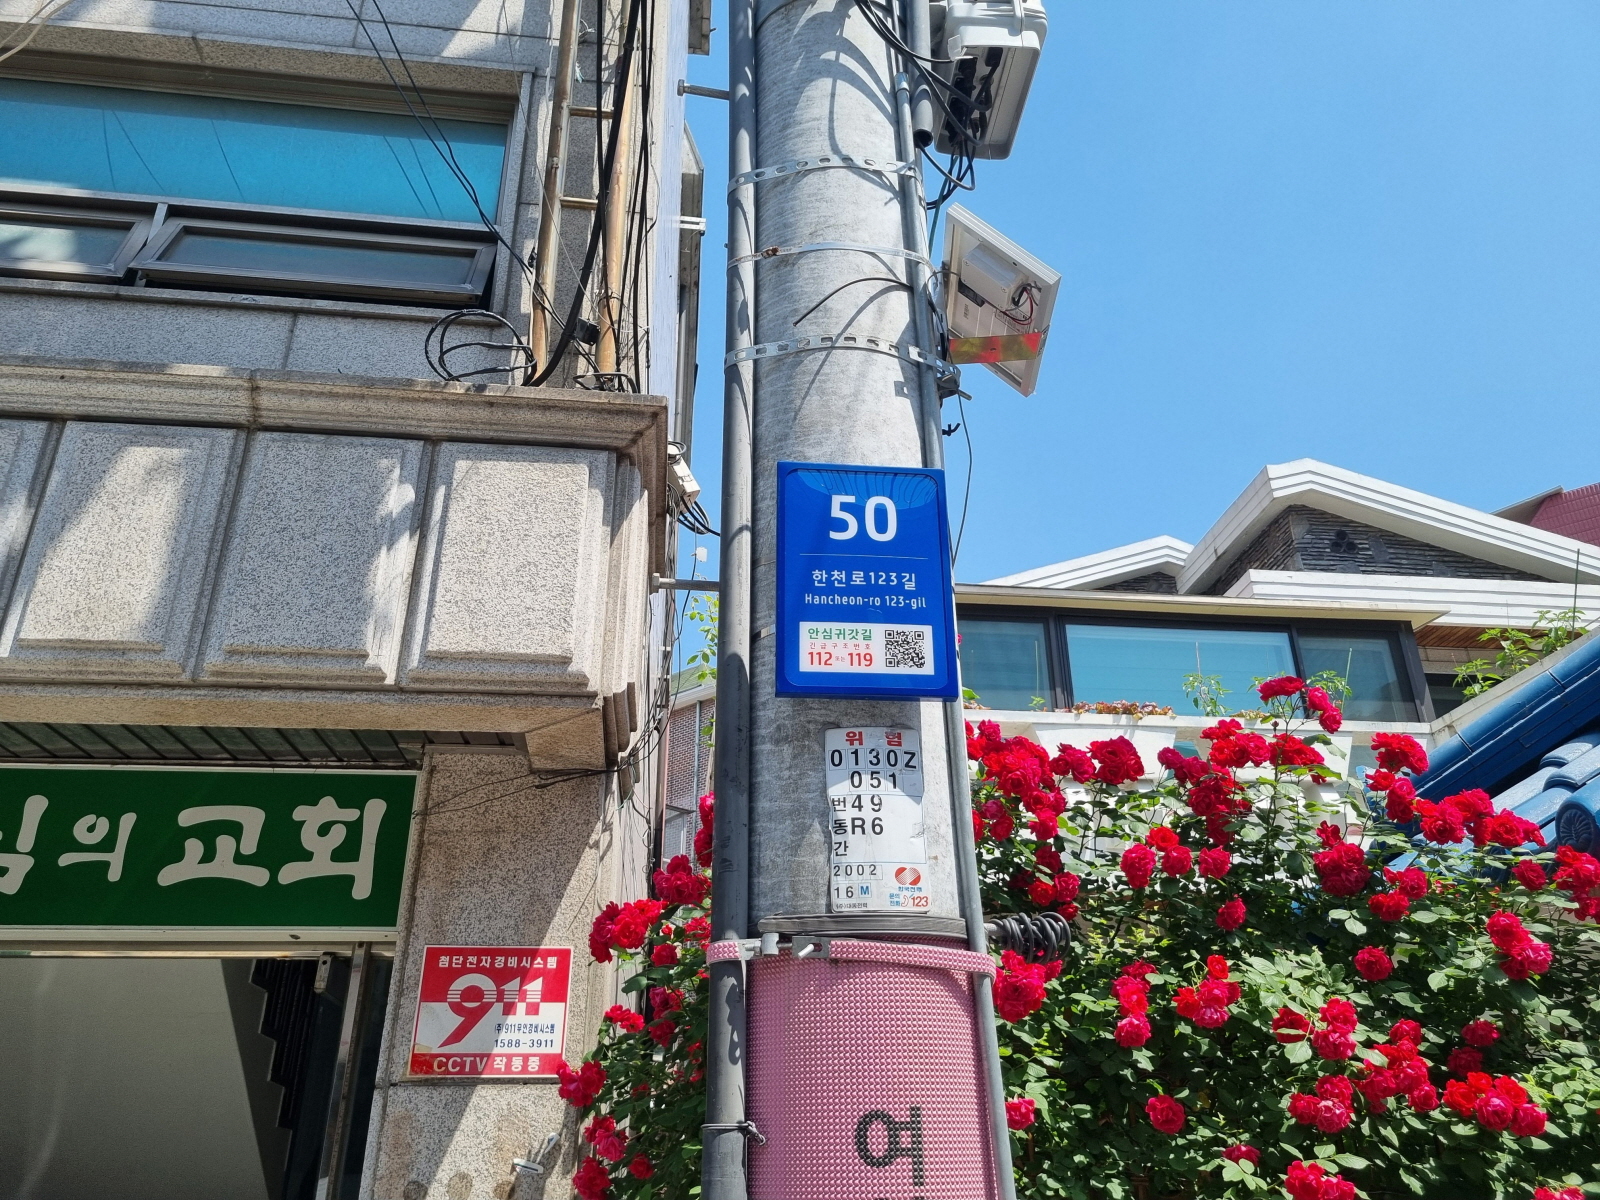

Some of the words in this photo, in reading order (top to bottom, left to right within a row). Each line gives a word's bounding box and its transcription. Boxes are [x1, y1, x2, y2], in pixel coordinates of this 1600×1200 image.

[829, 494, 898, 542] 50
[811, 569, 917, 590] 한천로123길
[805, 593, 881, 606] Hancheon-ro
[884, 595, 927, 609] 123-gil
[807, 627, 873, 641] 안심귀갓길
[807, 651, 833, 666] 112
[847, 652, 873, 667] 119
[845, 730, 903, 747] 위험
[850, 770, 897, 789] 051
[157, 795, 388, 900] 교회
[833, 863, 877, 877] 2002
[910, 895, 929, 908] 123
[438, 955, 558, 969] 첨단전자경비시스템
[437, 973, 543, 1049] 911
[494, 1038, 554, 1048] 1588-3911
[433, 1056, 488, 1072] CCTV
[493, 1056, 541, 1072] 작동중
[854, 1105, 925, 1200] 여
